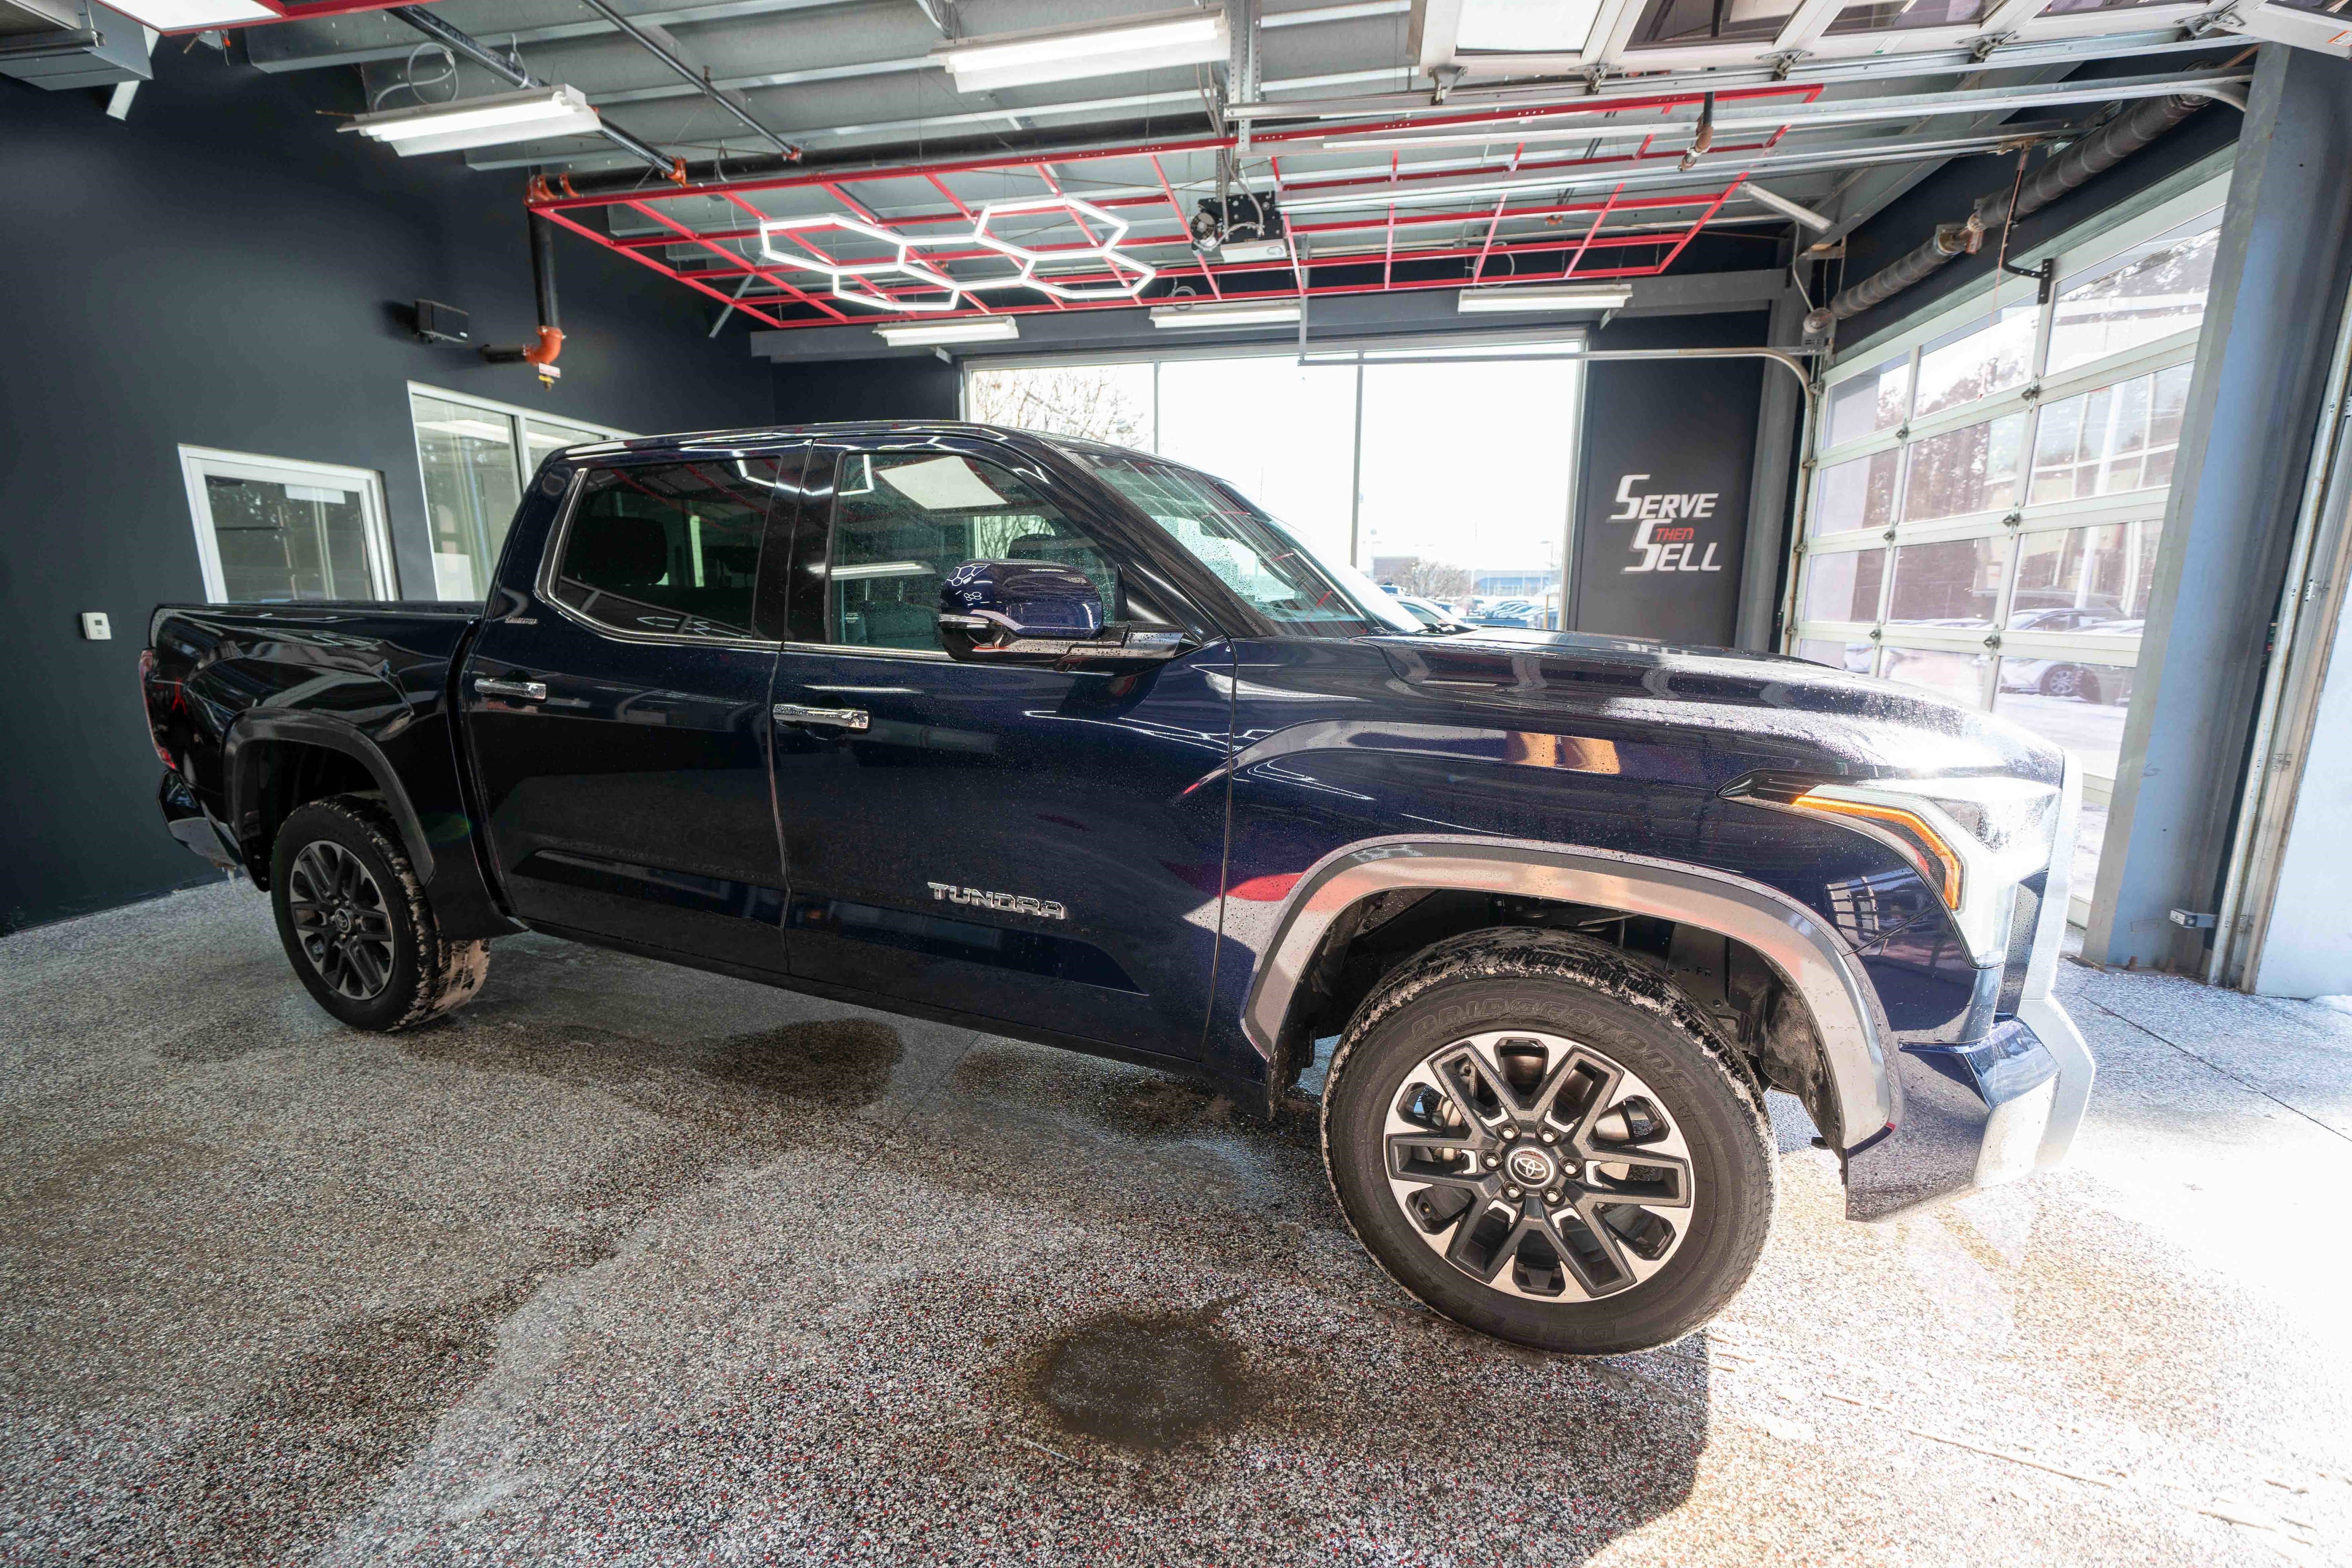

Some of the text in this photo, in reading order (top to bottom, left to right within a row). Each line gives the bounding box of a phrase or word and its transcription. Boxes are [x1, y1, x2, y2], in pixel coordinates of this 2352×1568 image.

[1610, 474, 1719, 519] SERVE
[1624, 518, 1722, 572] SELL
[1656, 528, 1694, 541] THEN
[927, 882, 1066, 919] TUNDRA
